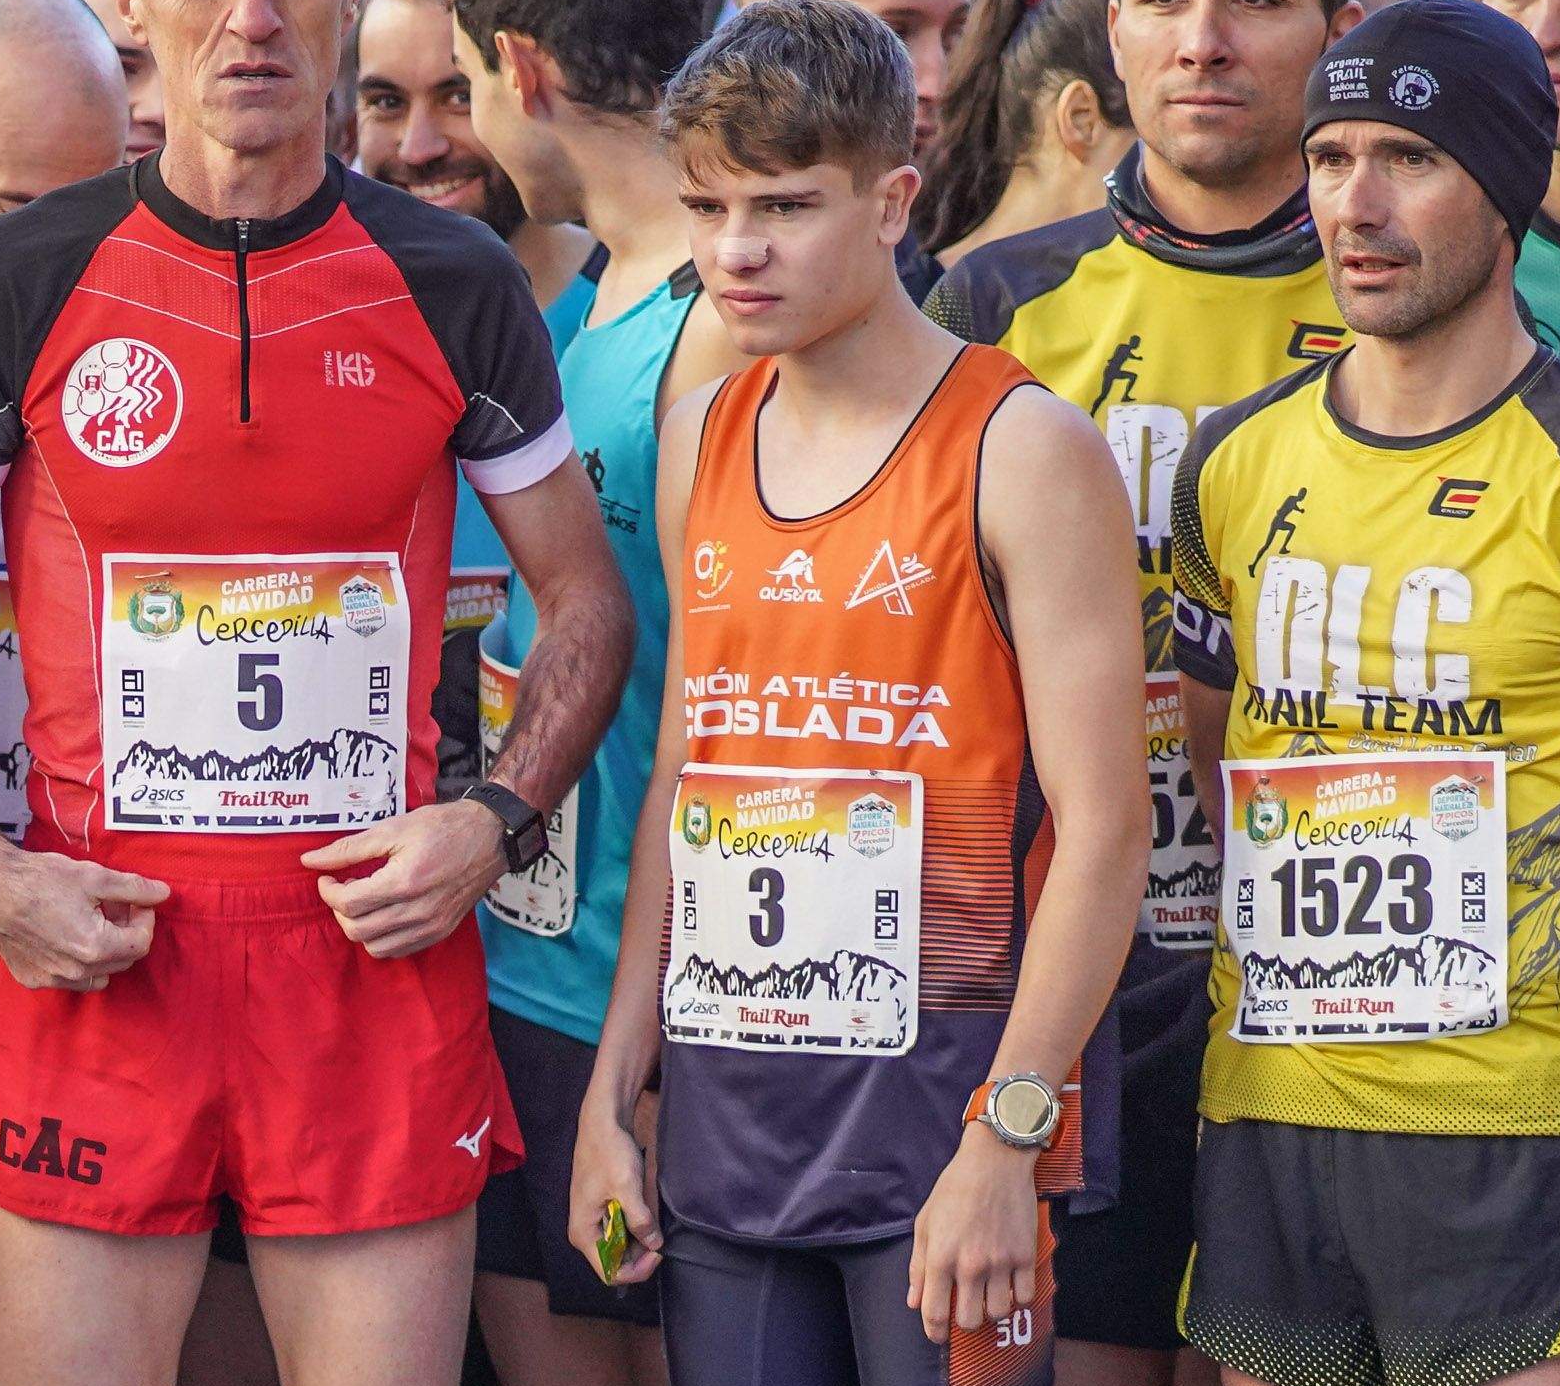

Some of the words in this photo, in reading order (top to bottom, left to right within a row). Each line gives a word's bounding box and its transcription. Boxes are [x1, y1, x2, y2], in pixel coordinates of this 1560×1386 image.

[1328, 67, 1367, 83] TRAIL
[96, 424, 144, 453] CAG
[221, 570, 298, 596] CARRERA
[302, 574, 314, 584] DE
[220, 584, 315, 616] NAVIDAD
[347, 611, 354, 623] 7
[355, 607, 382, 618] PICOS
[1255, 555, 1473, 709] DLC
[236, 653, 283, 731] 5
[684, 666, 750, 699] NIÓN
[760, 671, 952, 708] ATLÉTICA
[1356, 693, 1504, 736] TEAM
[148, 788, 185, 802] asics
[1315, 770, 1382, 797] CARRERA
[1384, 774, 1397, 783] DE
[218, 790, 268, 808] Trail
[267, 790, 310, 809] Run
[736, 785, 802, 809] CARRERA
[805, 790, 815, 799] DE
[1314, 785, 1397, 821] NAVIDAD
[735, 801, 815, 830] NAVIDAD
[1436, 814, 1443, 826] 7
[1444, 811, 1474, 820] PICOS
[852, 831, 861, 842] 7
[861, 828, 891, 837] PICOS
[748, 866, 786, 948] 3
[1270, 853, 1434, 938] 1523
[693, 1003, 721, 1015] asics
[737, 1006, 772, 1025] Trail
[771, 1007, 811, 1027] Run
[1257, 997, 1289, 1013] asics
[1312, 998, 1358, 1015] Trail
[1355, 997, 1395, 1016] Run
